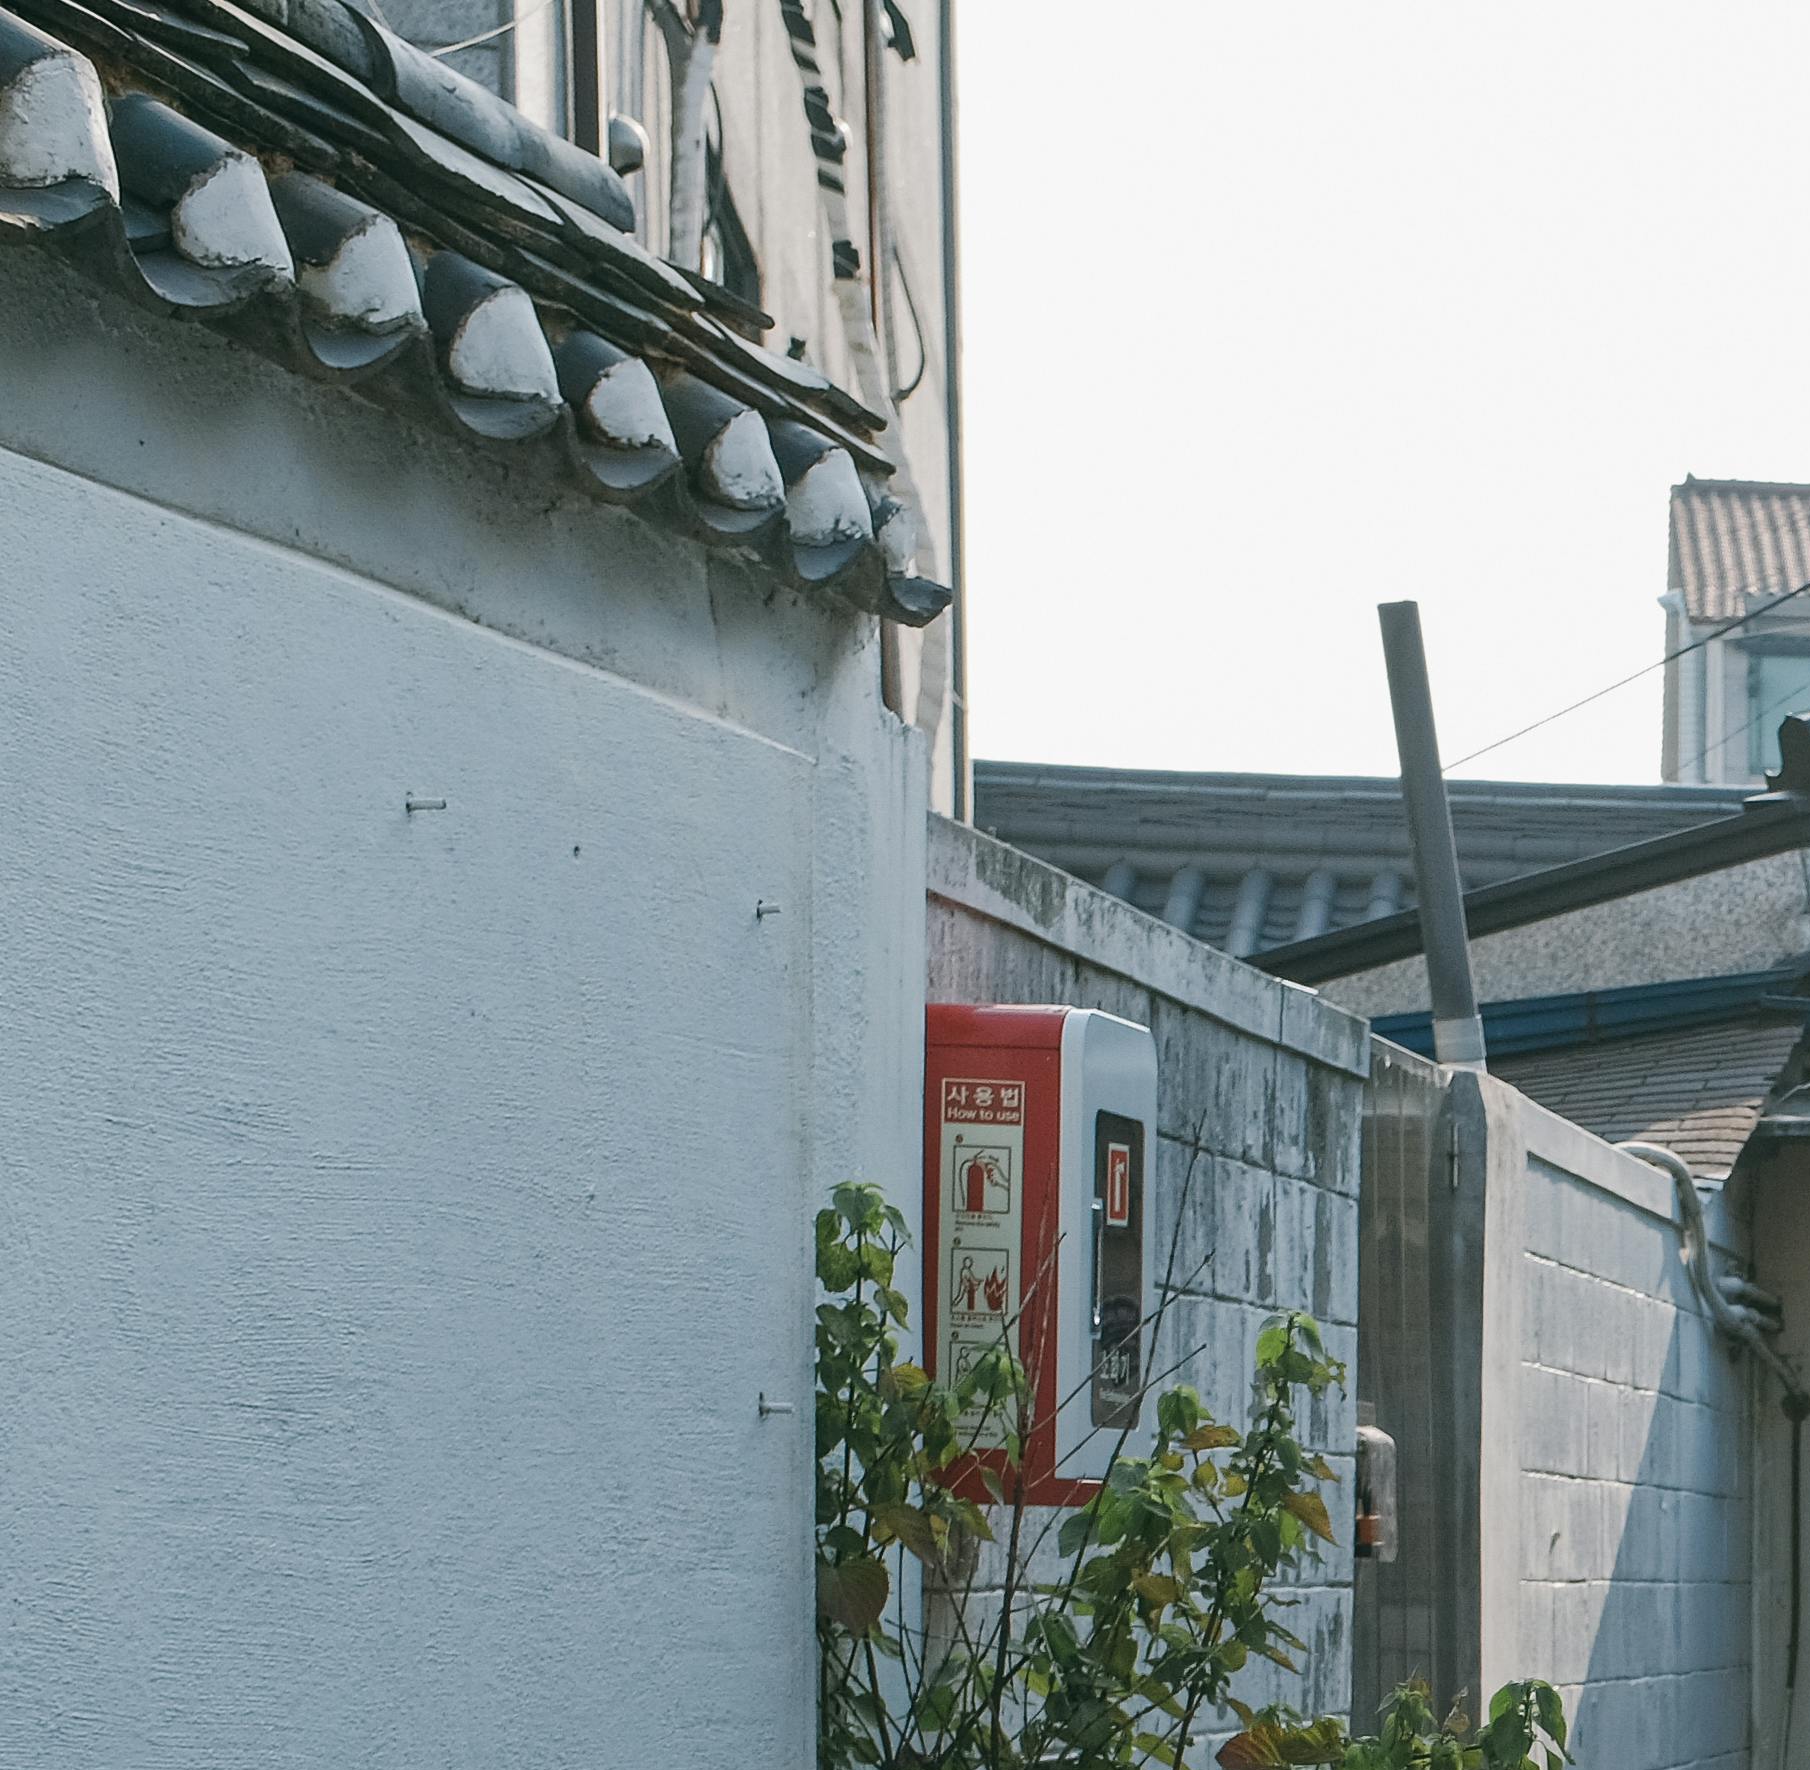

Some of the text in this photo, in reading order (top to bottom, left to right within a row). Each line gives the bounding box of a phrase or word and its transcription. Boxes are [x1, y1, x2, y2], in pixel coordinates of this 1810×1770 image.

[947, 1085, 1019, 1108] 사용법
[947, 1106, 1020, 1122] How to use
